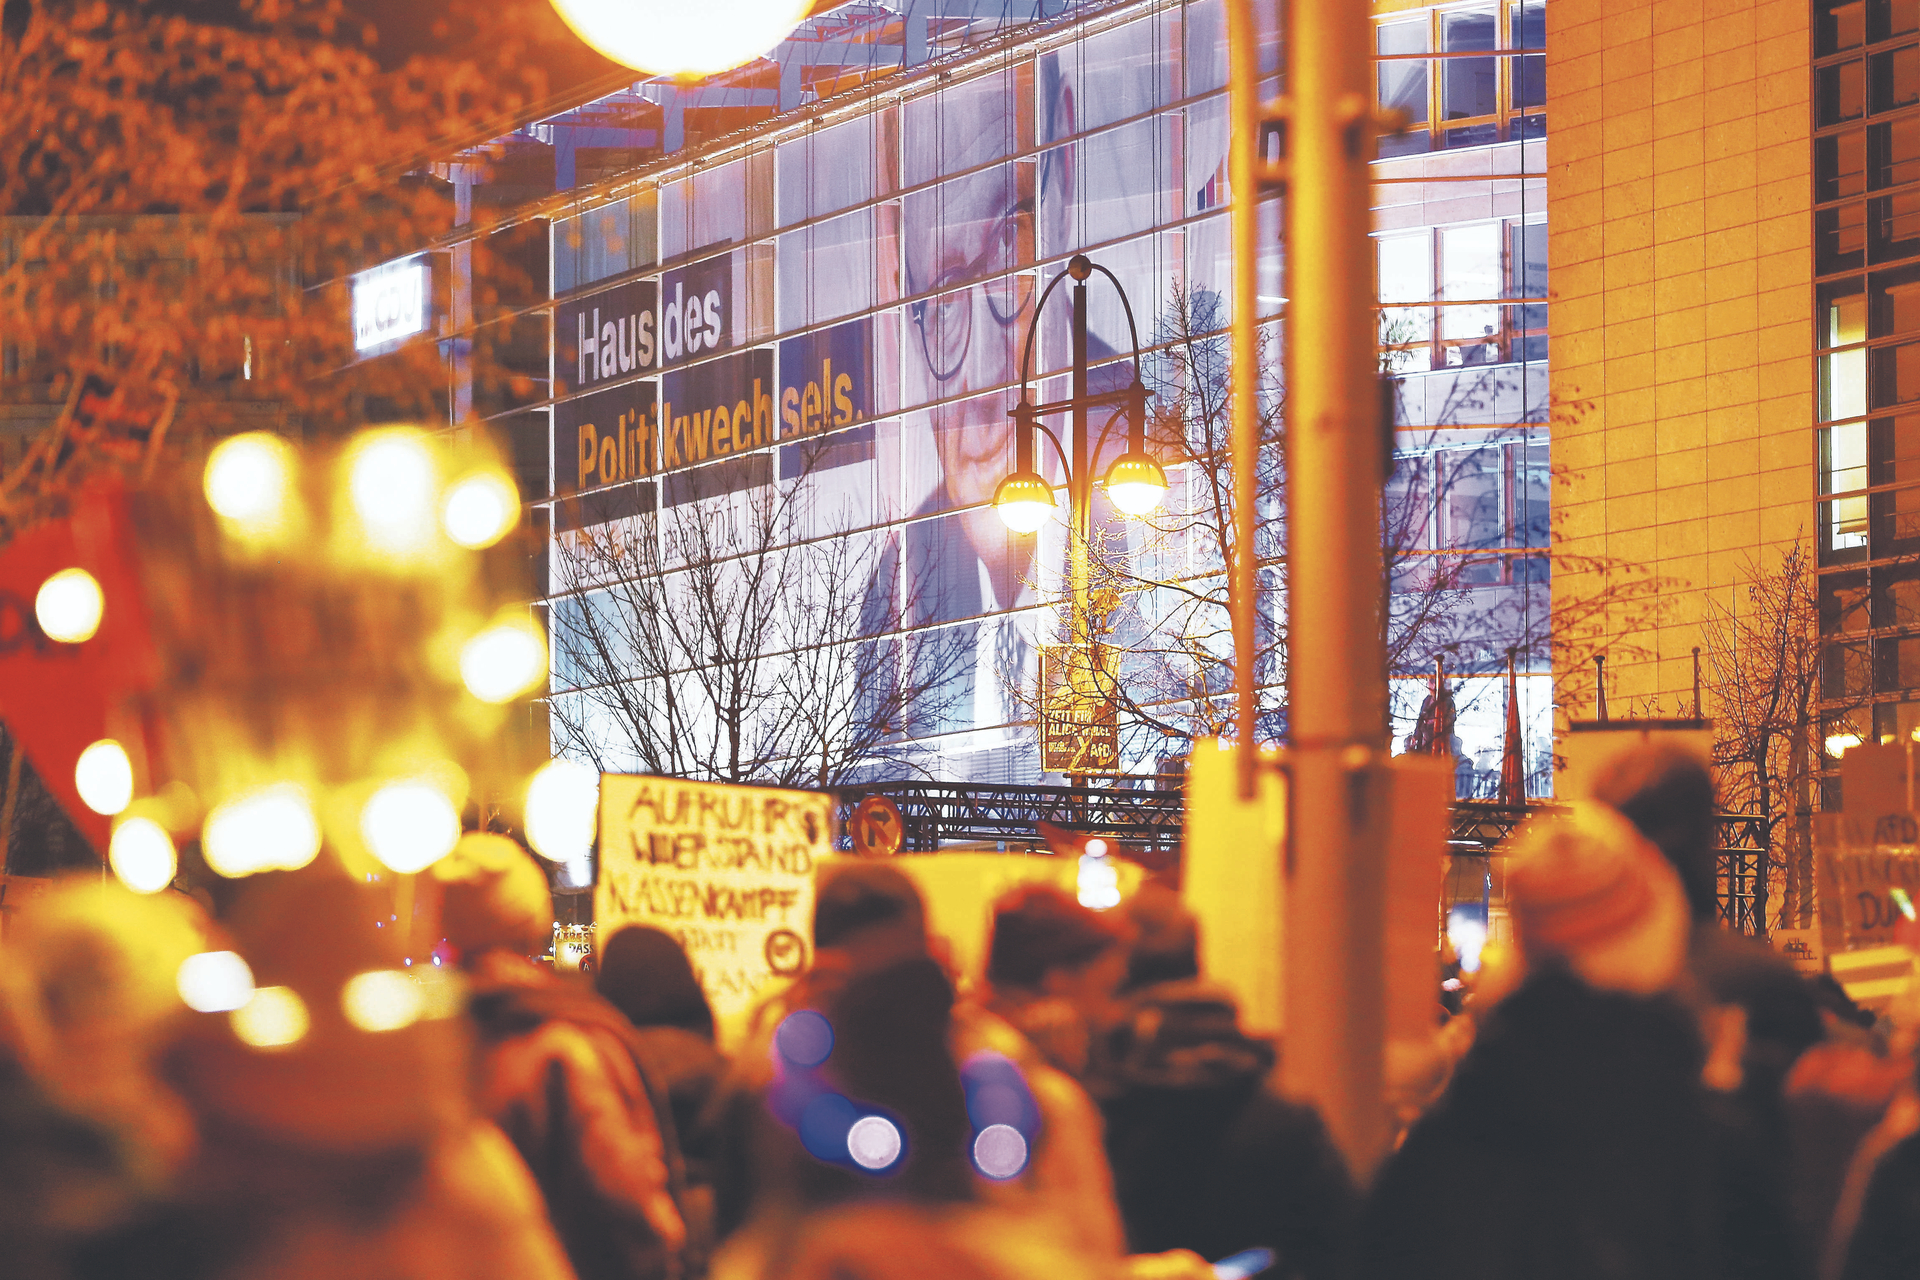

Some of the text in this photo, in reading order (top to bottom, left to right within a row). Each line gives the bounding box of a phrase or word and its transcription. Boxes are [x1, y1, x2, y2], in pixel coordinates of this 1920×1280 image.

[578, 282, 721, 384] Haus des
[578, 358, 863, 489] Politikwechsels.
